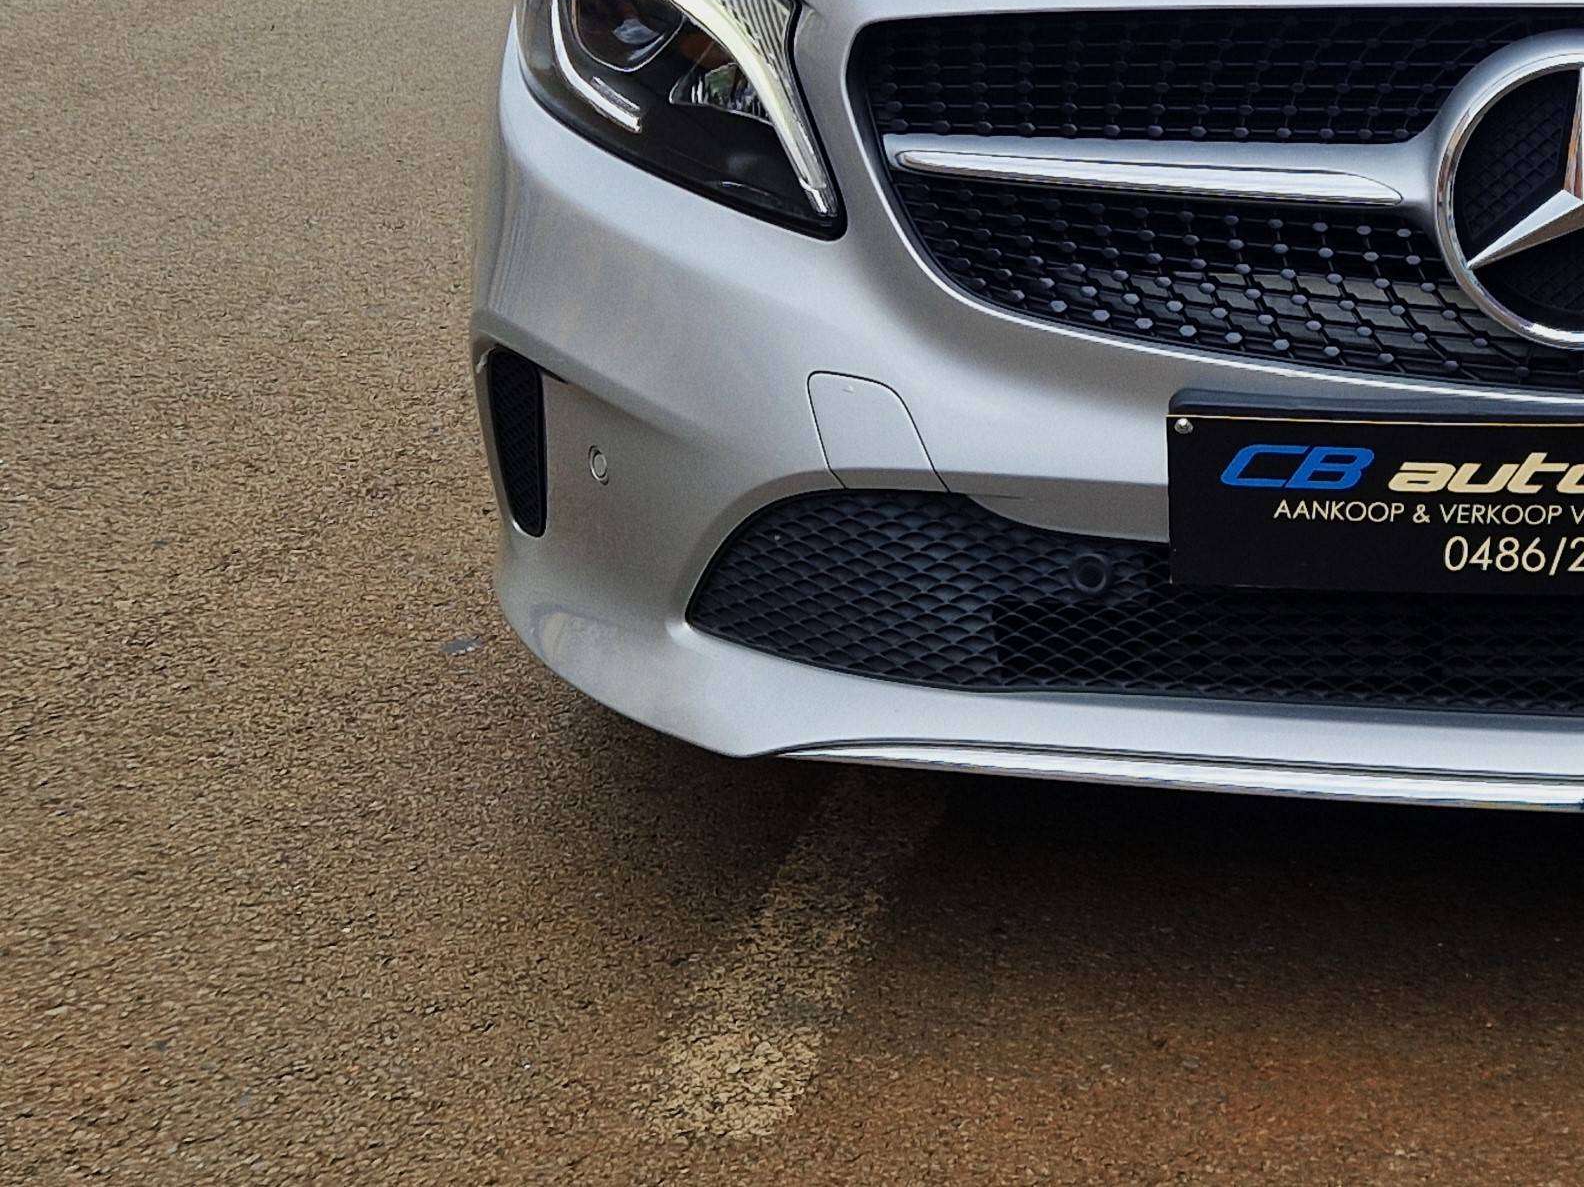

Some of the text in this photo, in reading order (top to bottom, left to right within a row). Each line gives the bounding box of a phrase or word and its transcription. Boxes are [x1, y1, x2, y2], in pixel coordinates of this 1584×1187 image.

[1220, 443, 1375, 490] CB
[1273, 499, 1405, 523] AANKOOP
[1412, 503, 1431, 524] &
[1439, 503, 1563, 525] VERKOOP
